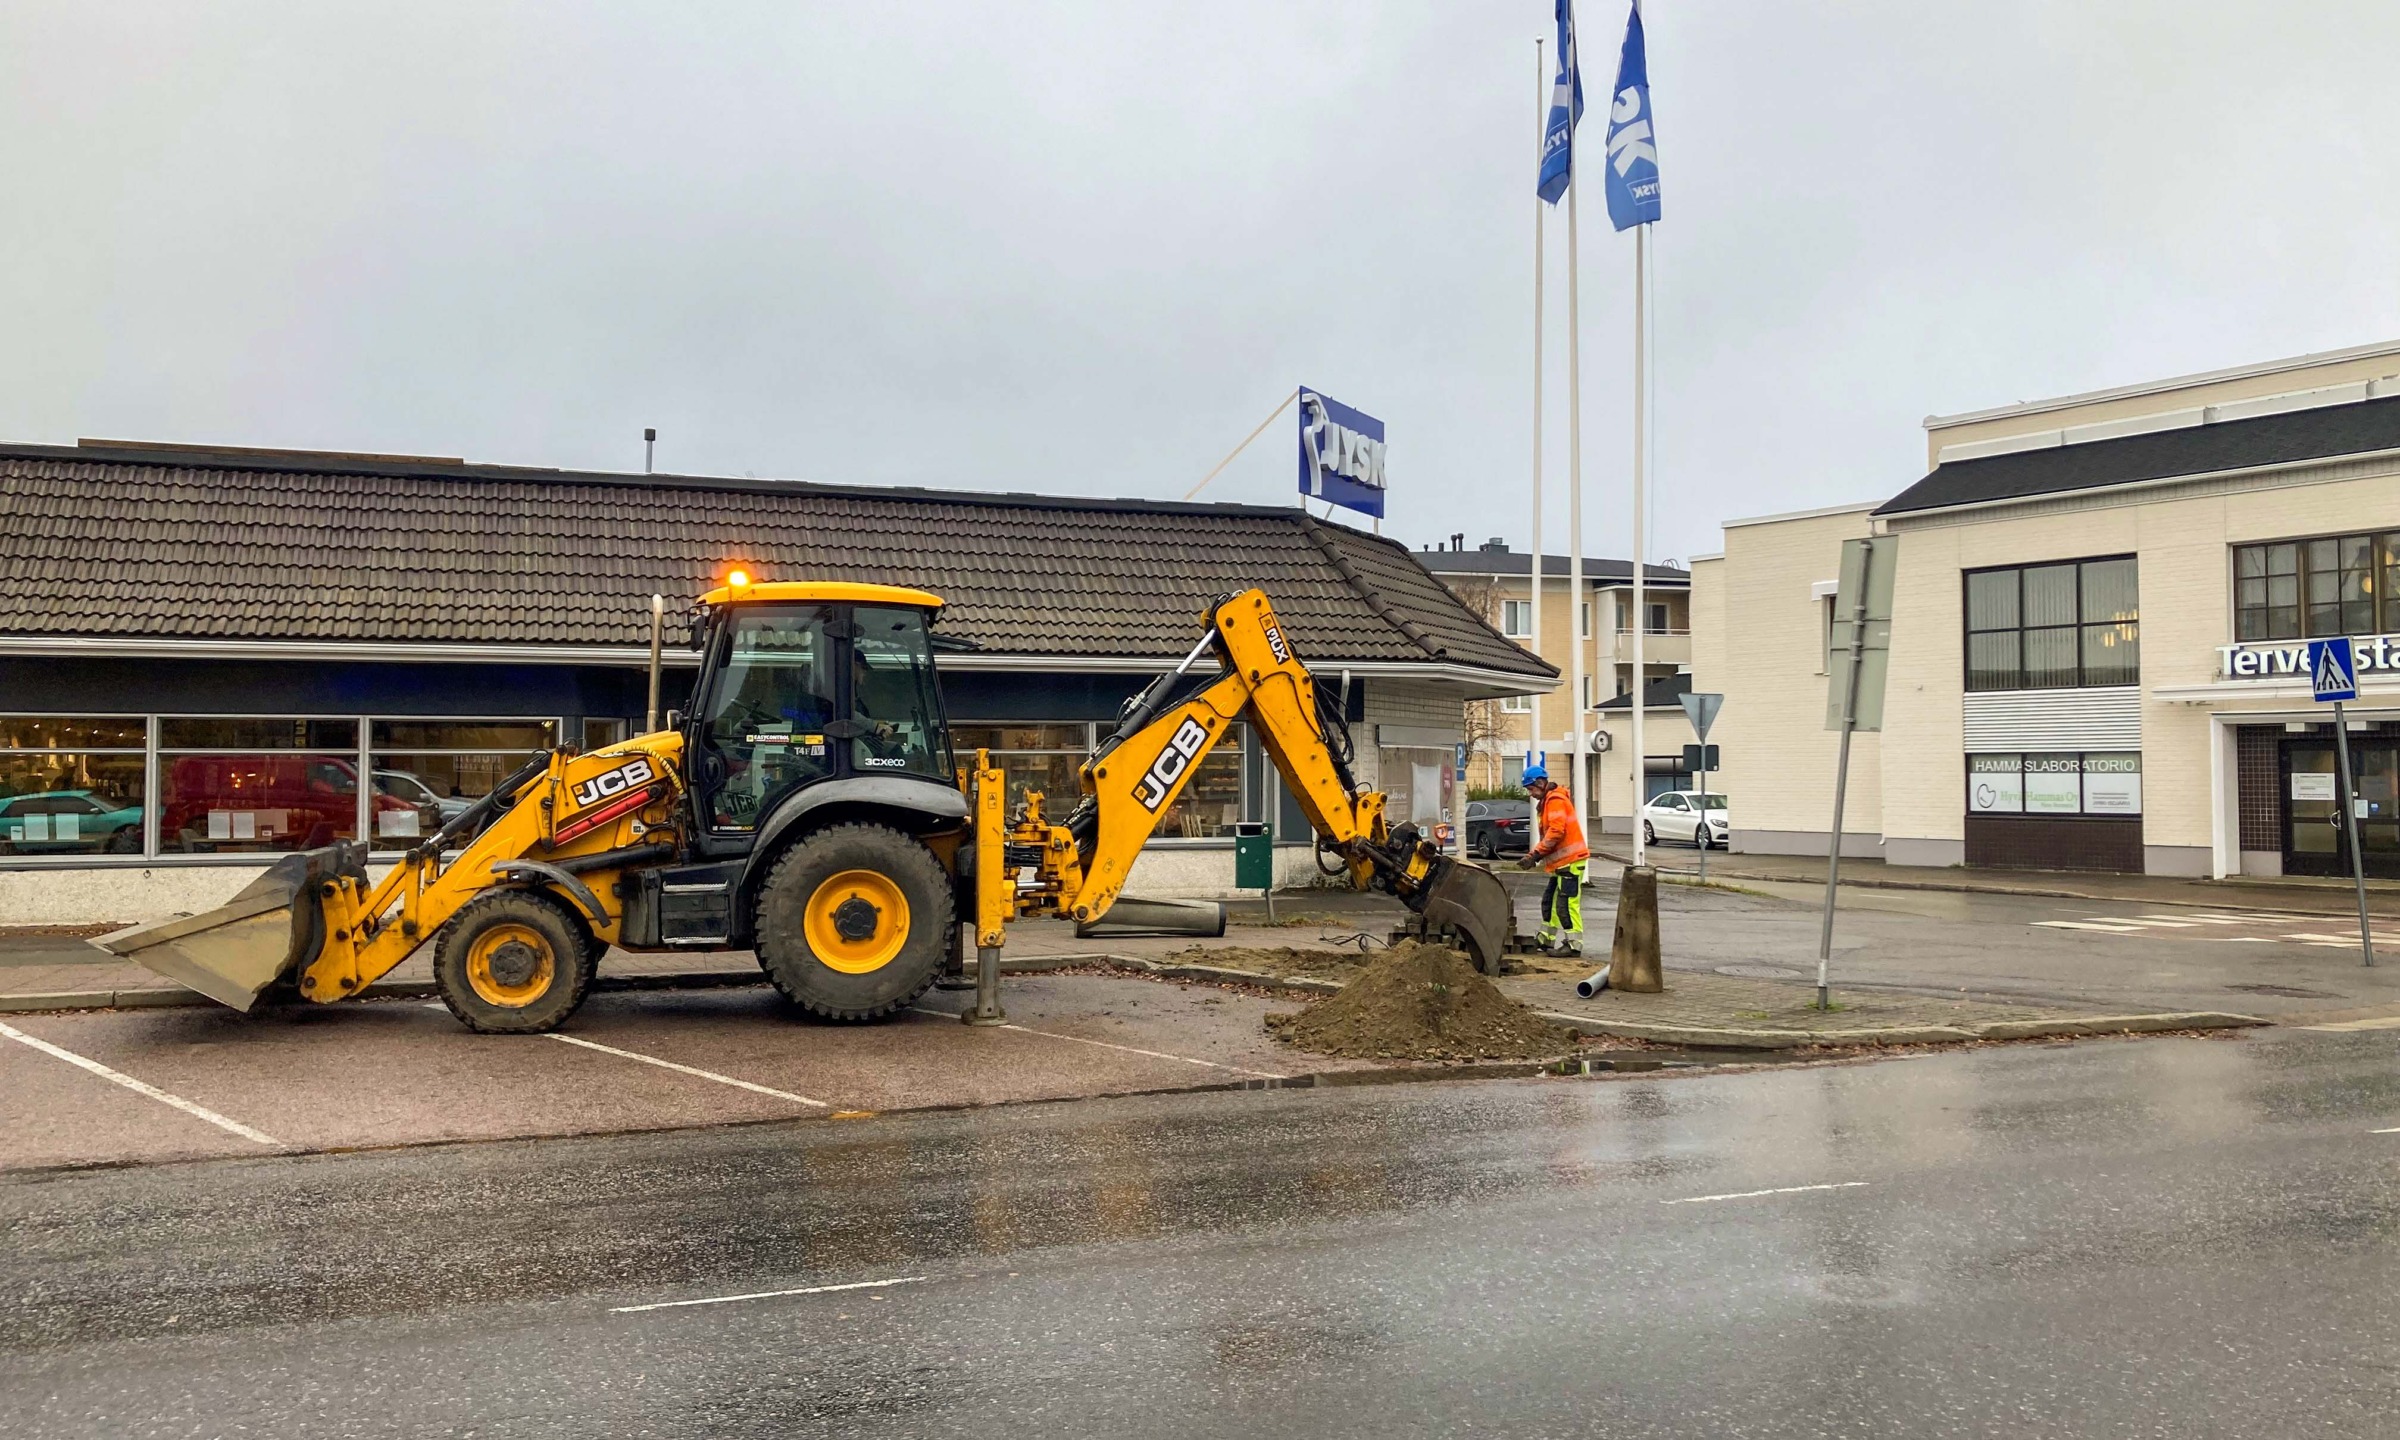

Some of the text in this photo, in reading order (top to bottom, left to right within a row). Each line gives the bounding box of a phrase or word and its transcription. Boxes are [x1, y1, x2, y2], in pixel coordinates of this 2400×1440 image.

[1320, 422, 1388, 490] JYSK
[864, 757, 906, 767] 3CXeco
[1144, 719, 1206, 809] JCB
[1975, 760, 2135, 772] HAMMASLABORATORIO
[578, 760, 652, 805] JCB
[727, 793, 757, 816] JCB
